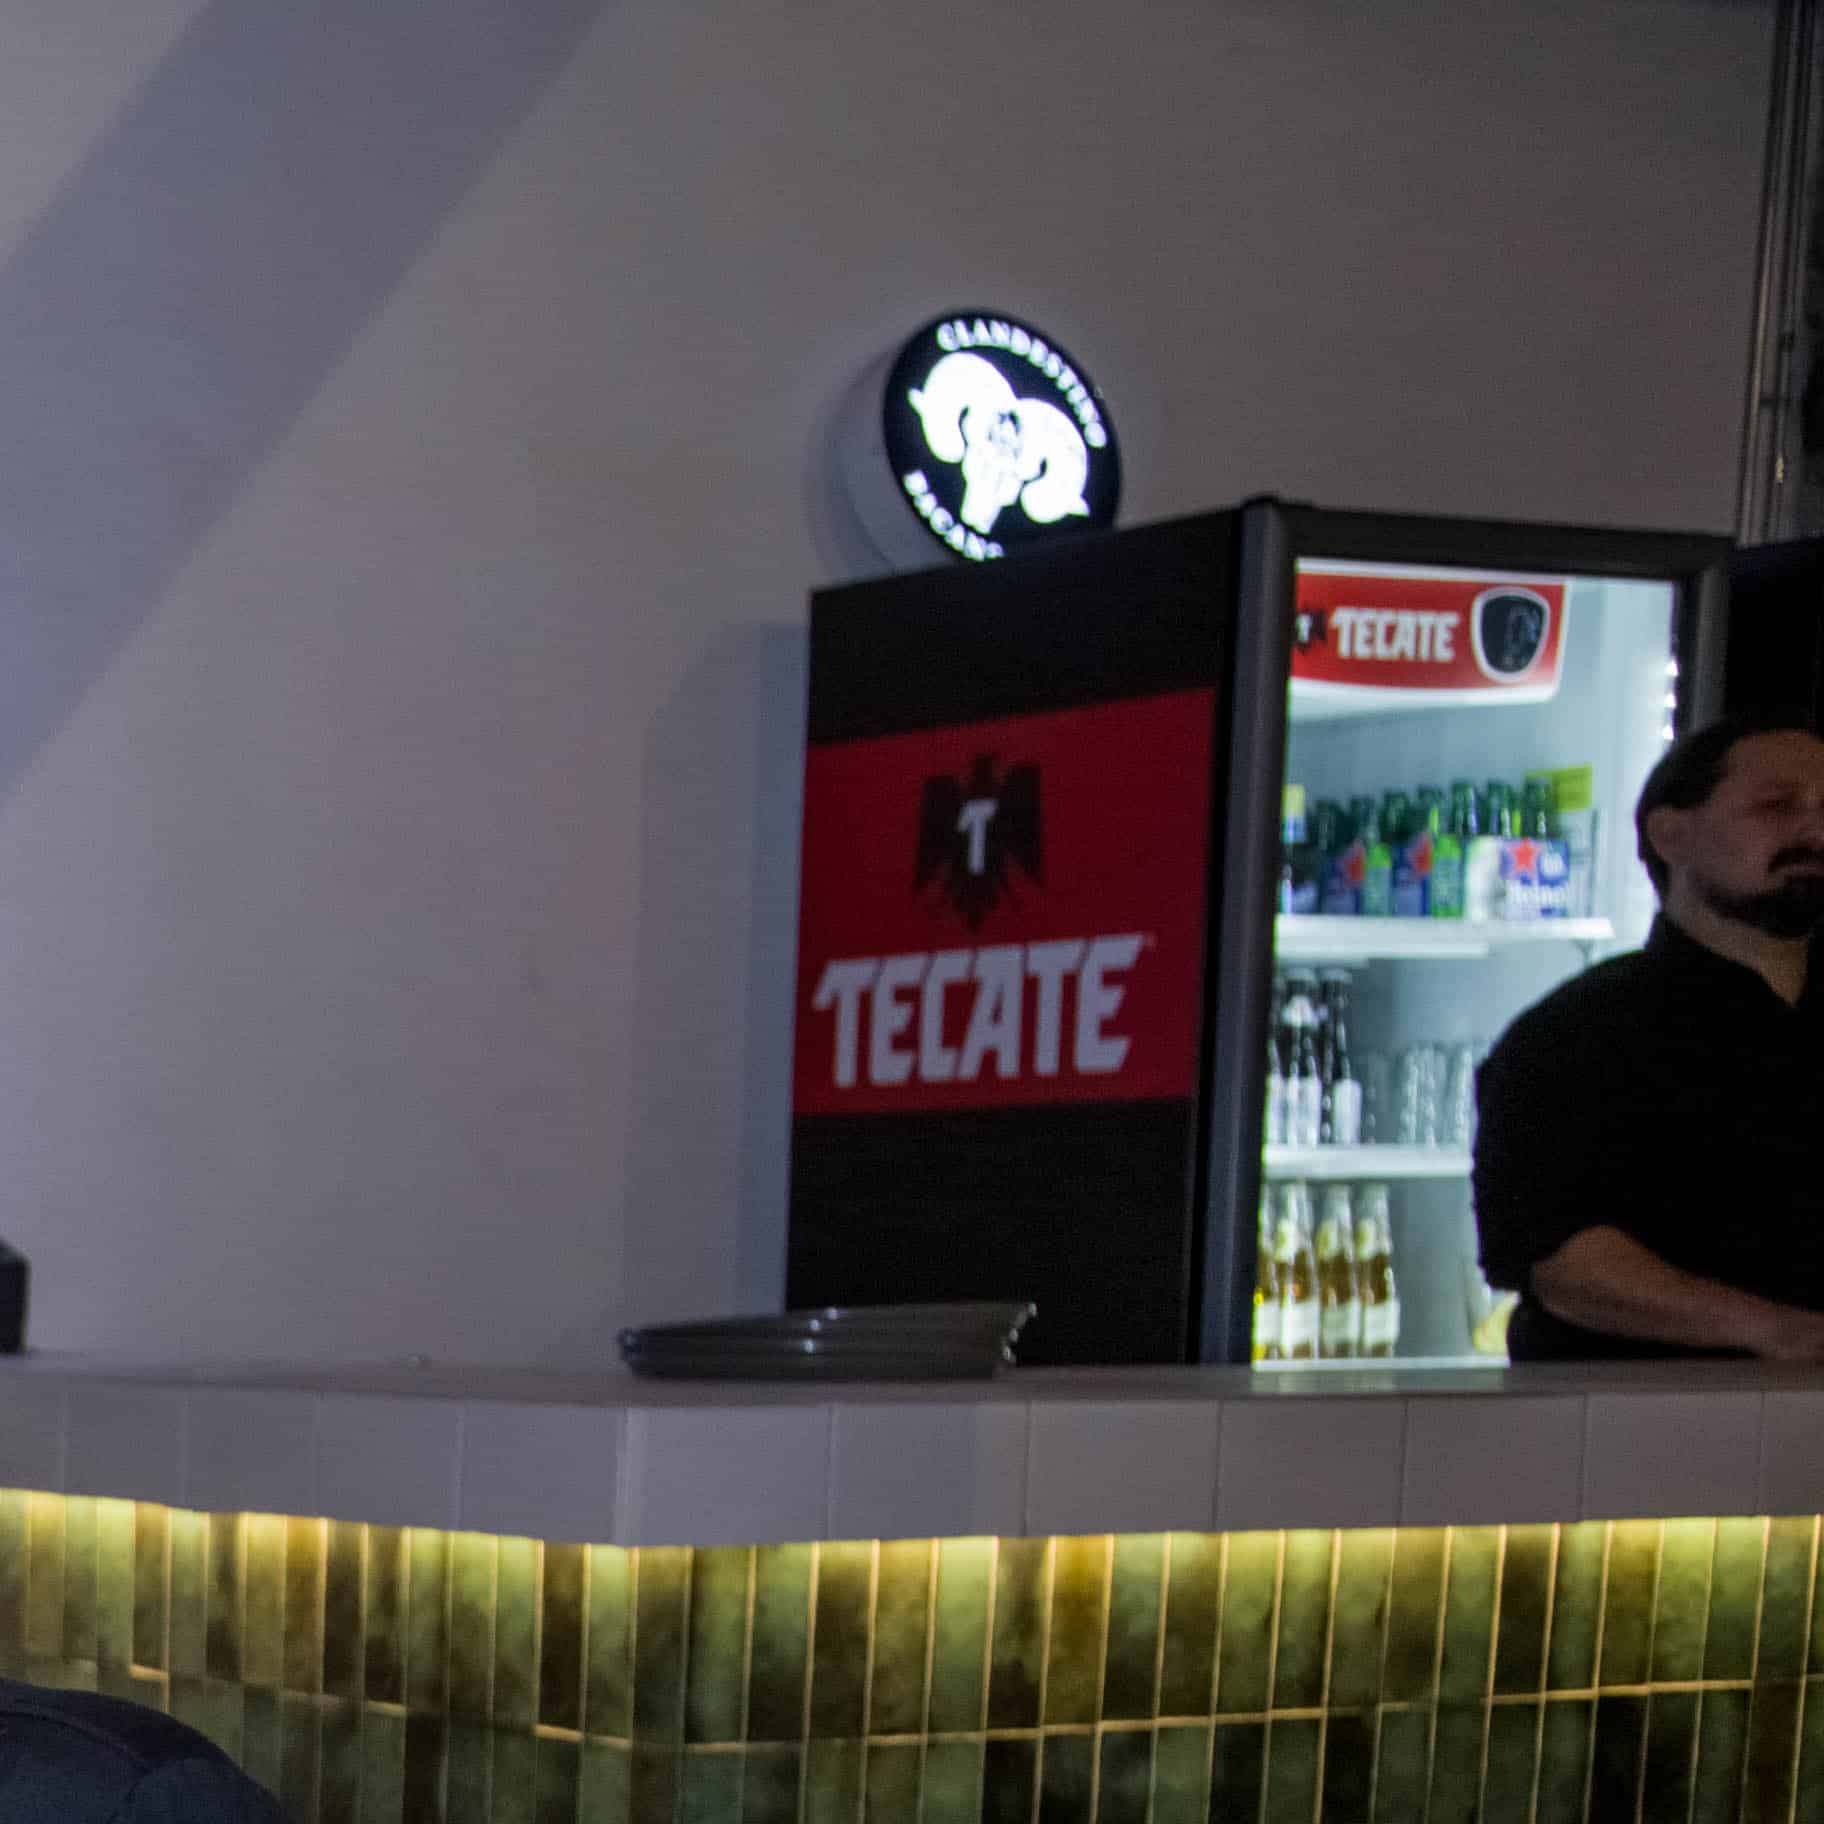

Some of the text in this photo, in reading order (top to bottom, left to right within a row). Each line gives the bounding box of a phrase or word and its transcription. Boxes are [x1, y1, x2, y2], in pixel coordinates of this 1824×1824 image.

[936, 318, 1107, 448] CLANDESTINO
[1330, 605, 1461, 664] TECATE
[811, 932, 1146, 1090] TECATE
